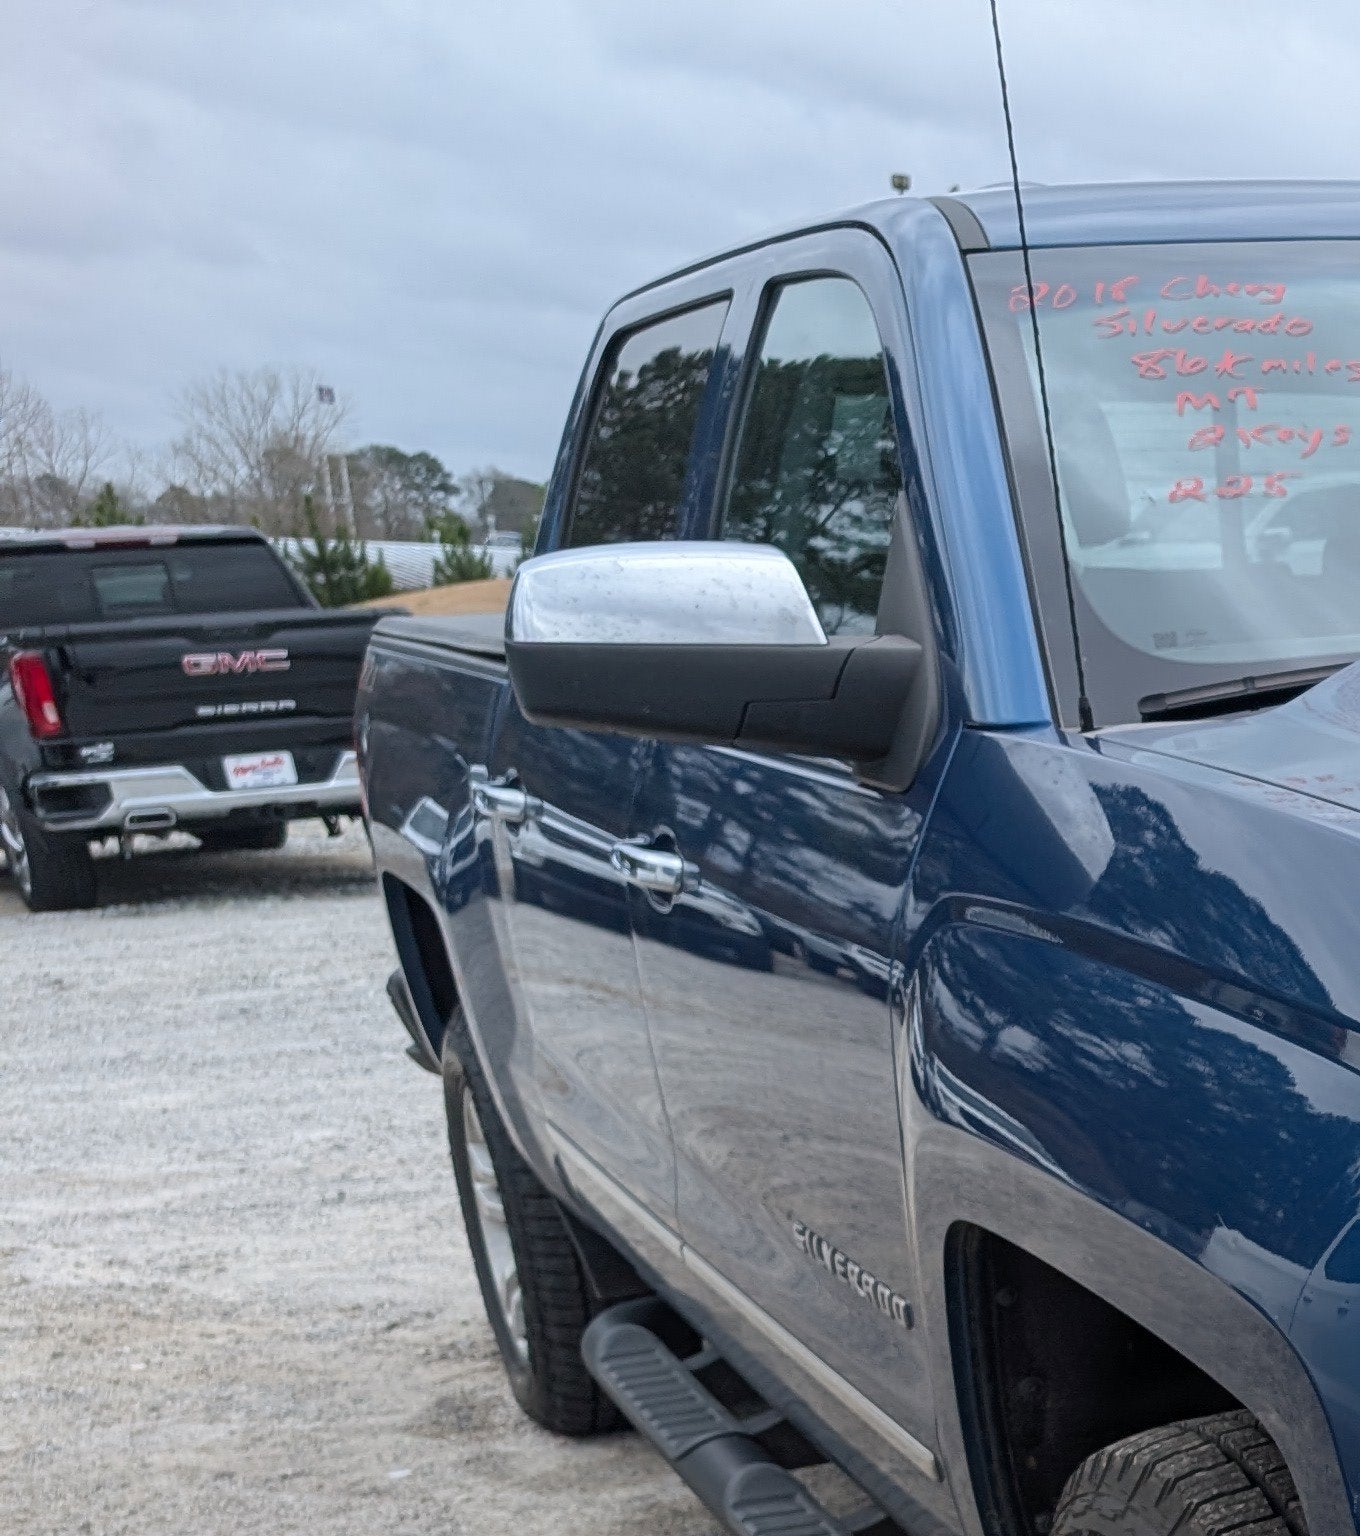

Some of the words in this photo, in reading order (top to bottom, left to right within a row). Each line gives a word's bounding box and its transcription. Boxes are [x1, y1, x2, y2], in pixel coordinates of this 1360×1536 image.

[1093, 306, 1313, 338] Silverado
[182, 649, 291, 676] GMC
[792, 1220, 911, 1327] SILVERADO
